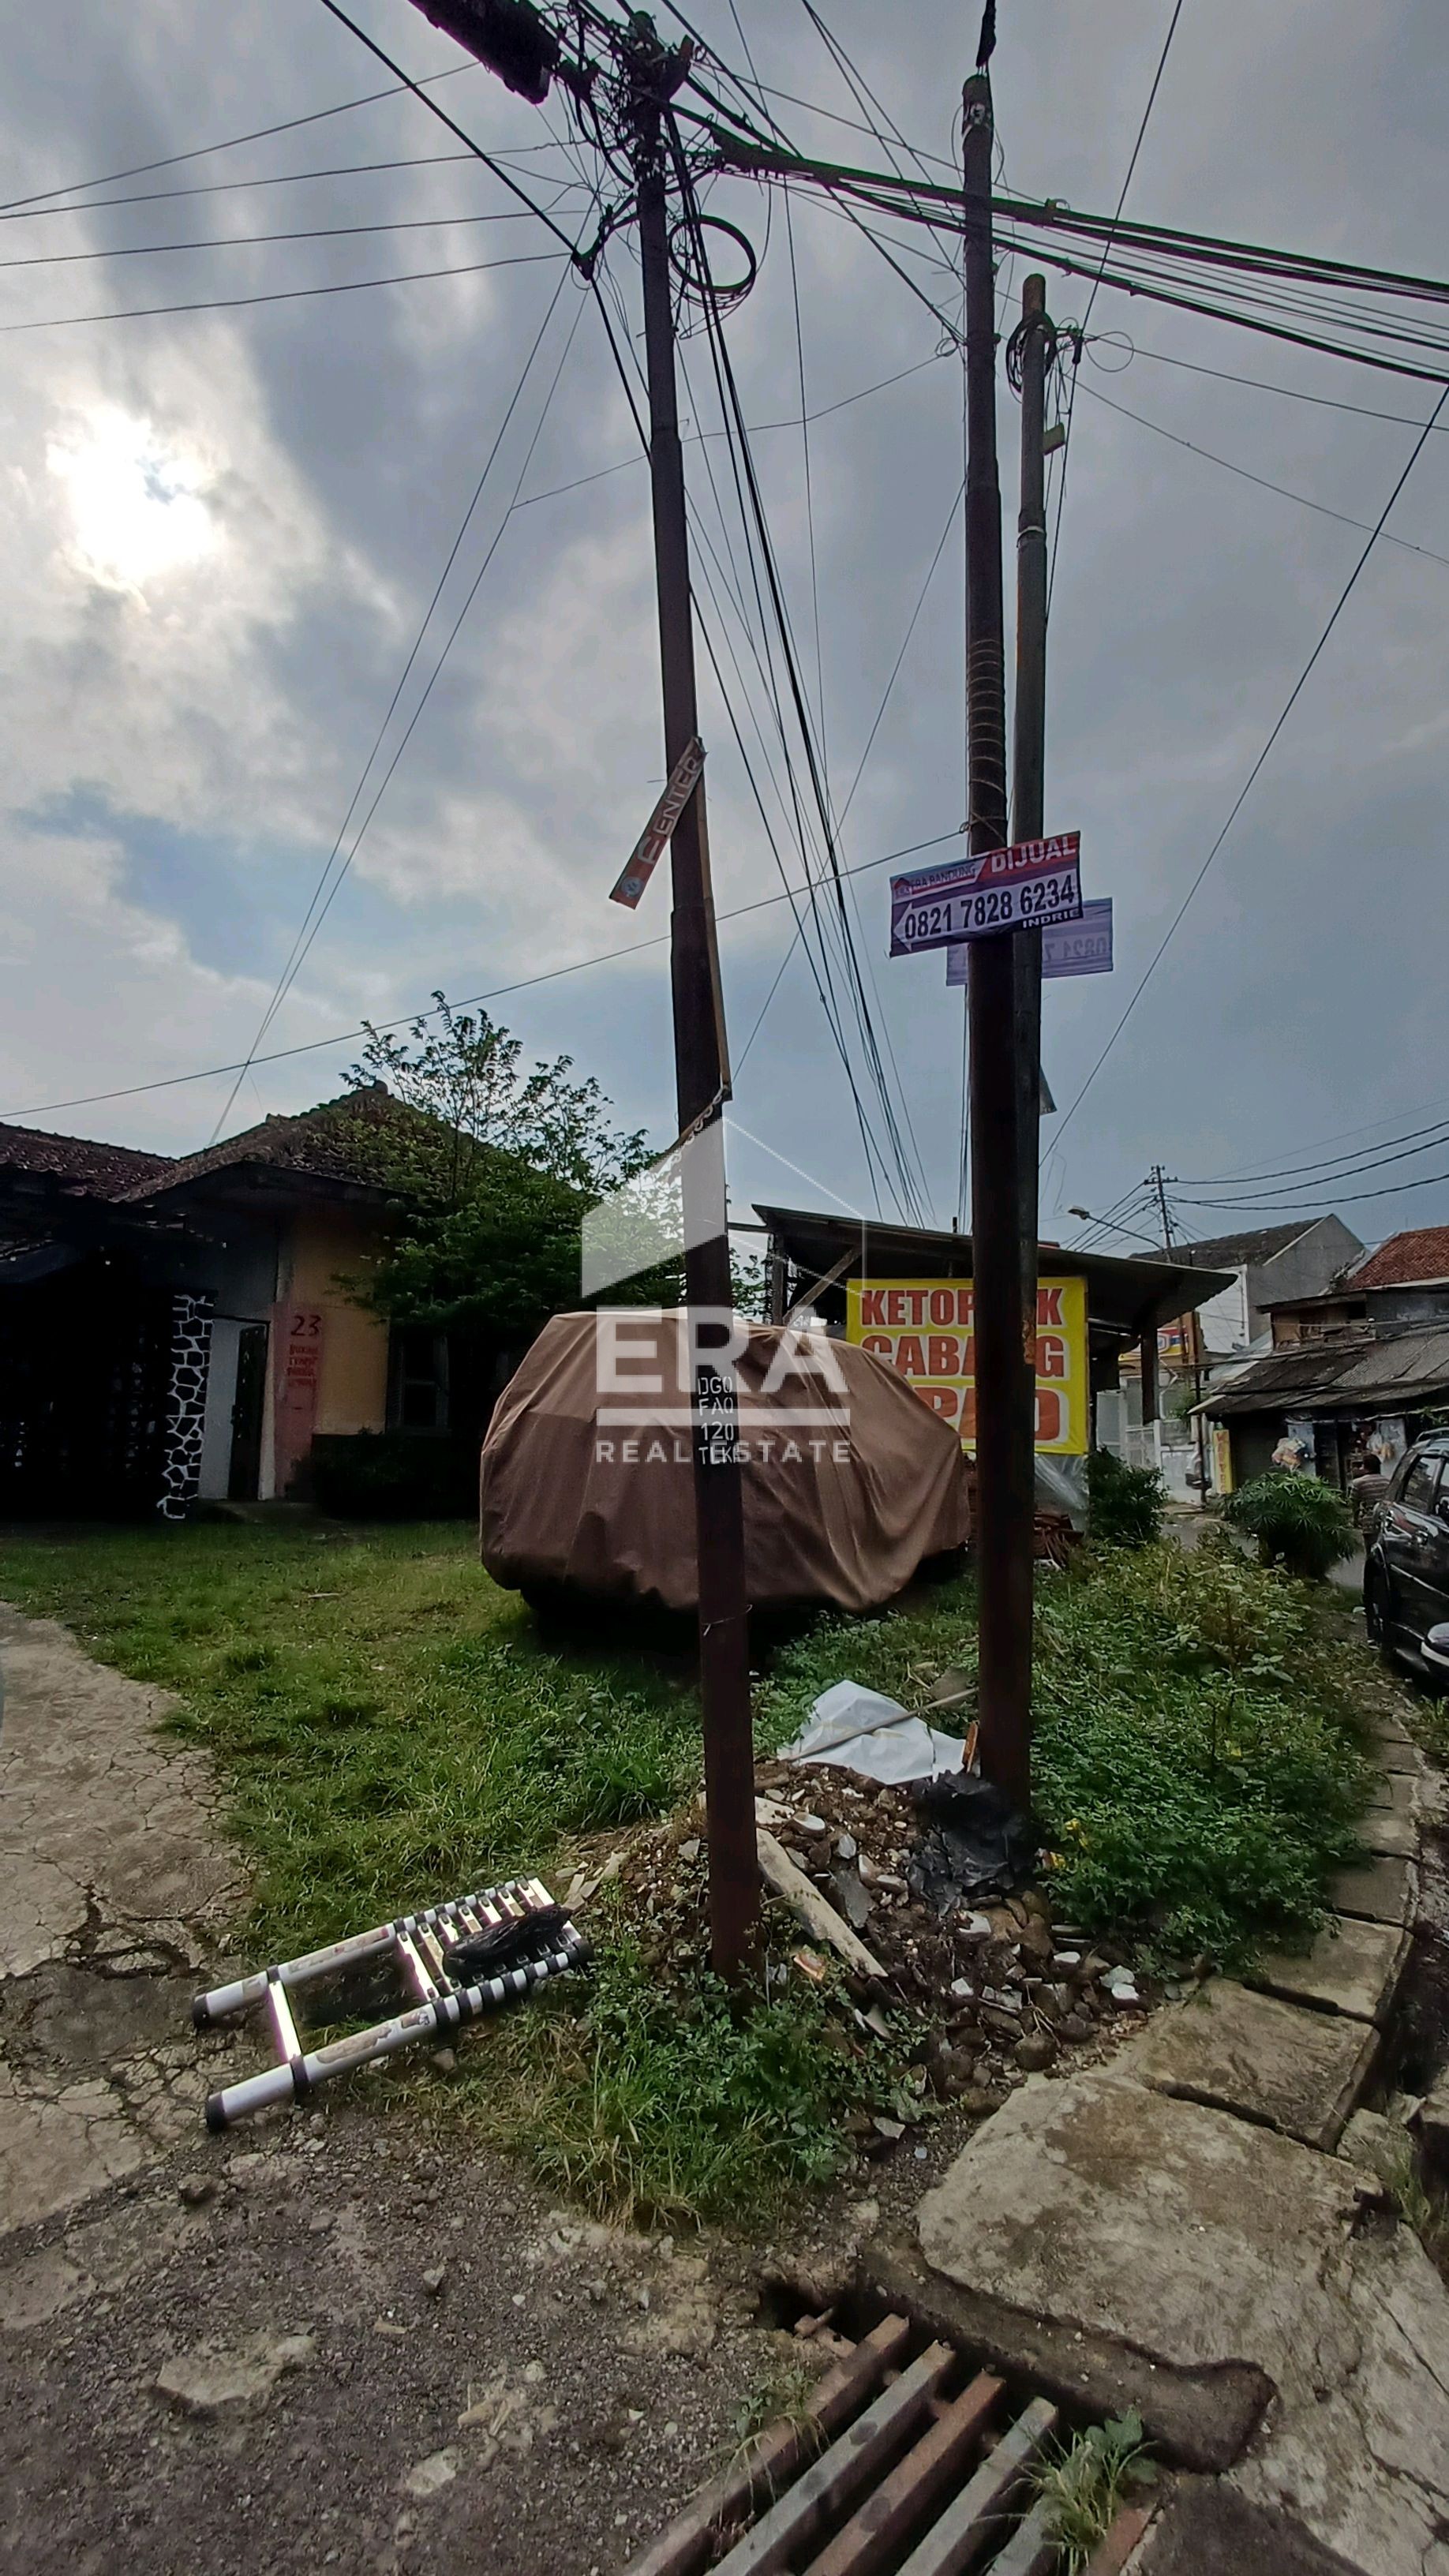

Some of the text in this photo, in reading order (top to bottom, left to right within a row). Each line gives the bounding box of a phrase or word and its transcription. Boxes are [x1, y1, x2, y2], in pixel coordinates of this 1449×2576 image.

[991, 837, 1076, 872] DIJUAL
[904, 874, 1075, 939] 0821 7828 6234
[291, 1315, 322, 1335] 23
[861, 1289, 1063, 1326] KETOPK
[701, 1421, 734, 1441] 120
